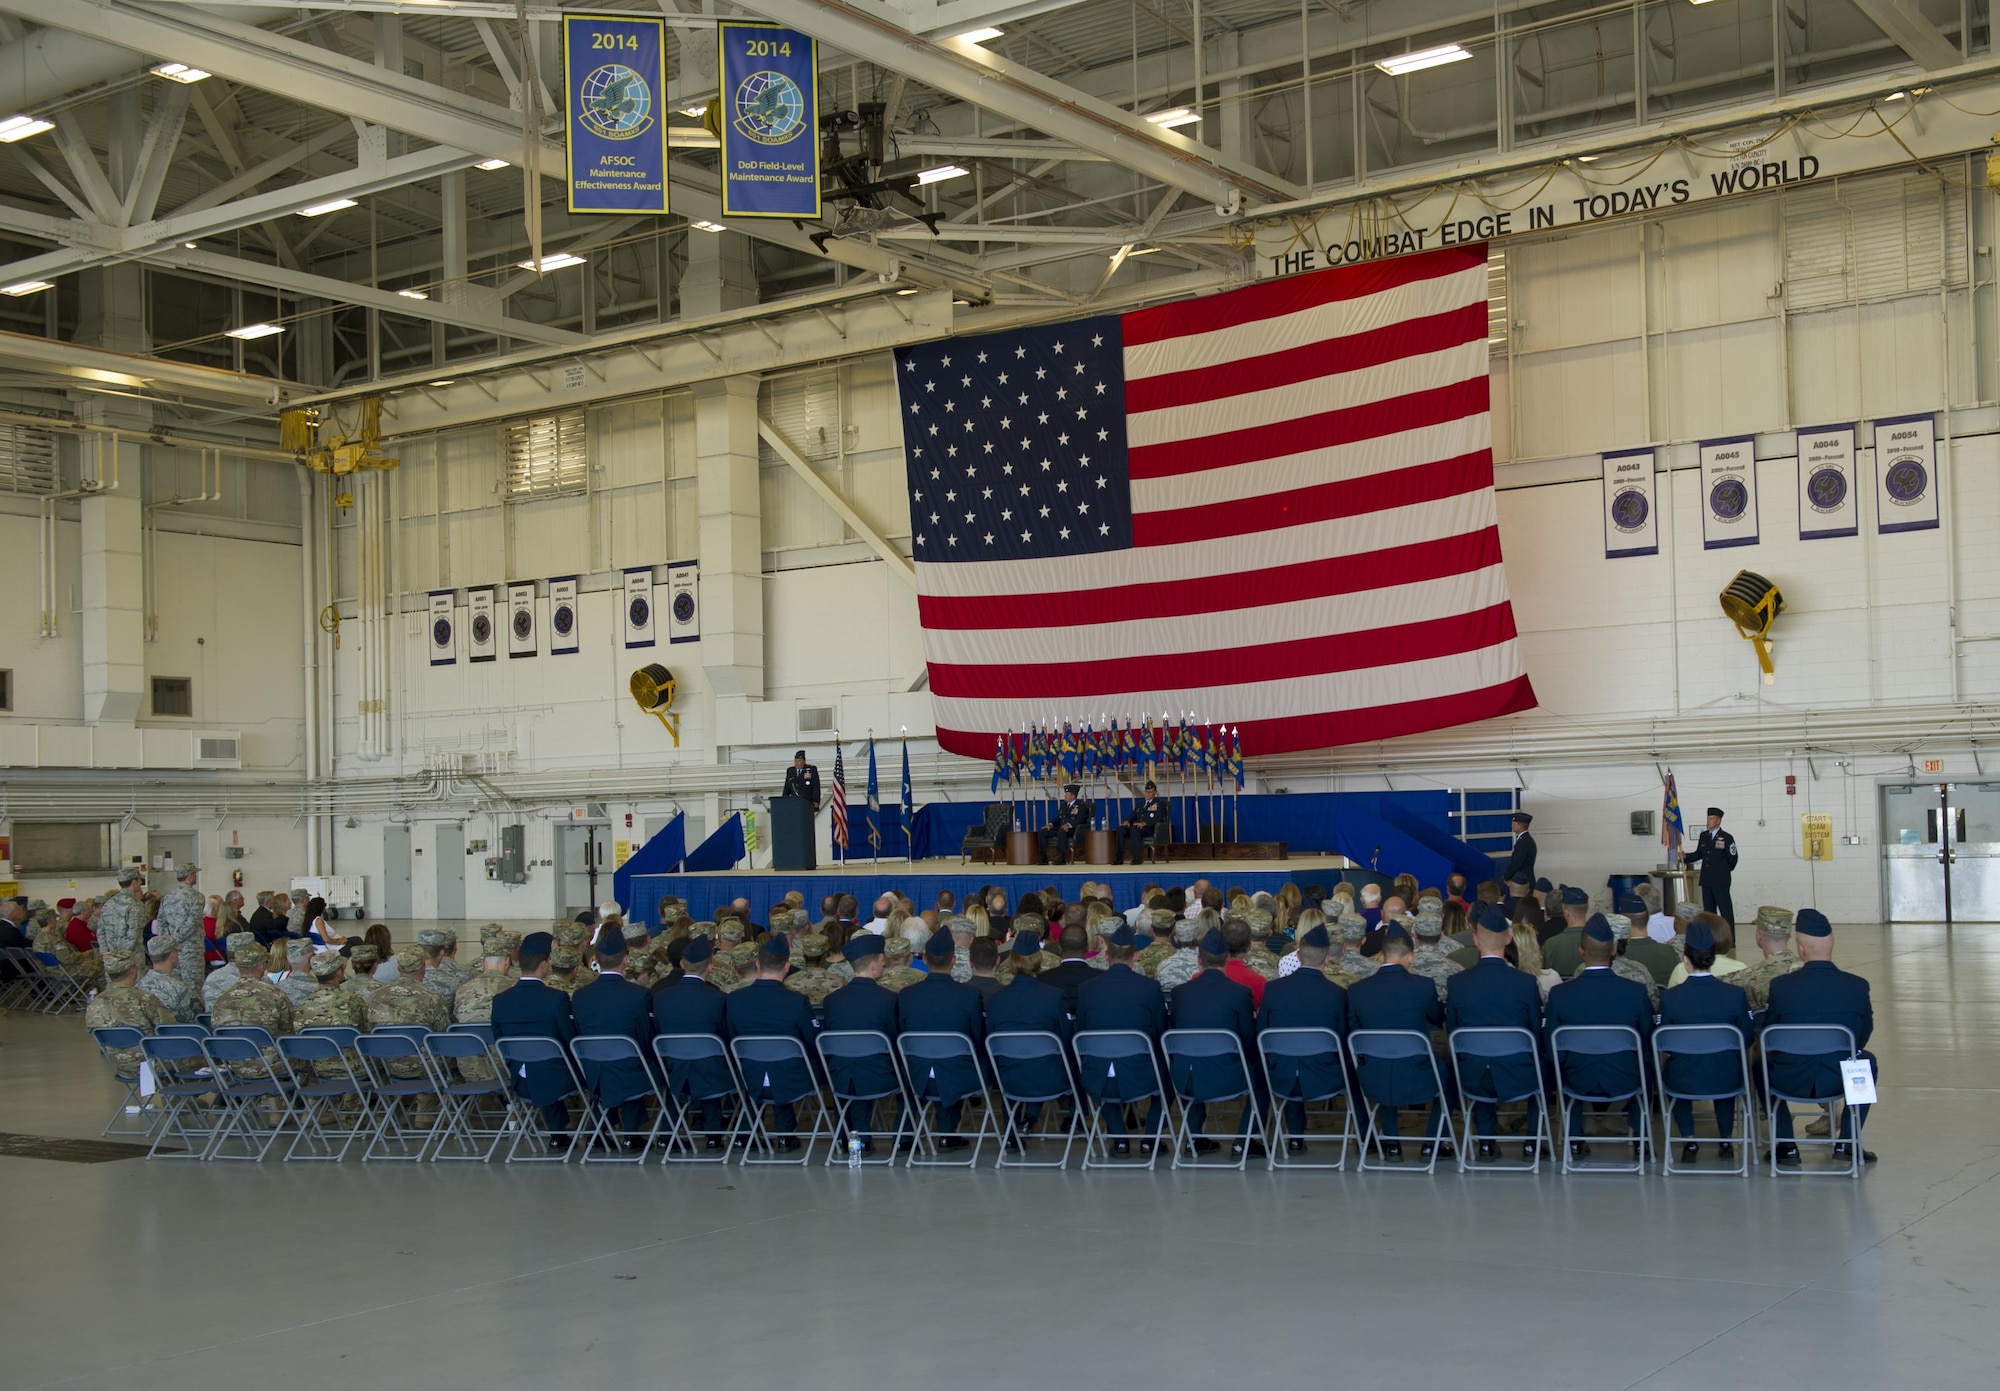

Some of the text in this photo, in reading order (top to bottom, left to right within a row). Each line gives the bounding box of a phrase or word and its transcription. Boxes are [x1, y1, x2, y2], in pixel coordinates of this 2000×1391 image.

[591, 33, 639, 50] 2014
[746, 40, 792, 57] 2014
[599, 155, 636, 167] AFSOC
[738, 160, 805, 171] DoD Field-Level
[589, 168, 647, 179] Maintenance
[729, 172, 814, 183] Maintenance Award
[575, 181, 662, 191] Effectiveness Award
[1270, 155, 1819, 276] THE COMBAT EDGE IN TODAY'S WORLD
[1890, 430, 1918, 441] A0054
[1812, 440, 1840, 449] A0046
[1715, 451, 1741, 461] A0045
[1925, 759, 1940, 771] EXIT
[1806, 815, 1826, 823] START
[1804, 831, 1830, 839] SYSTEM
